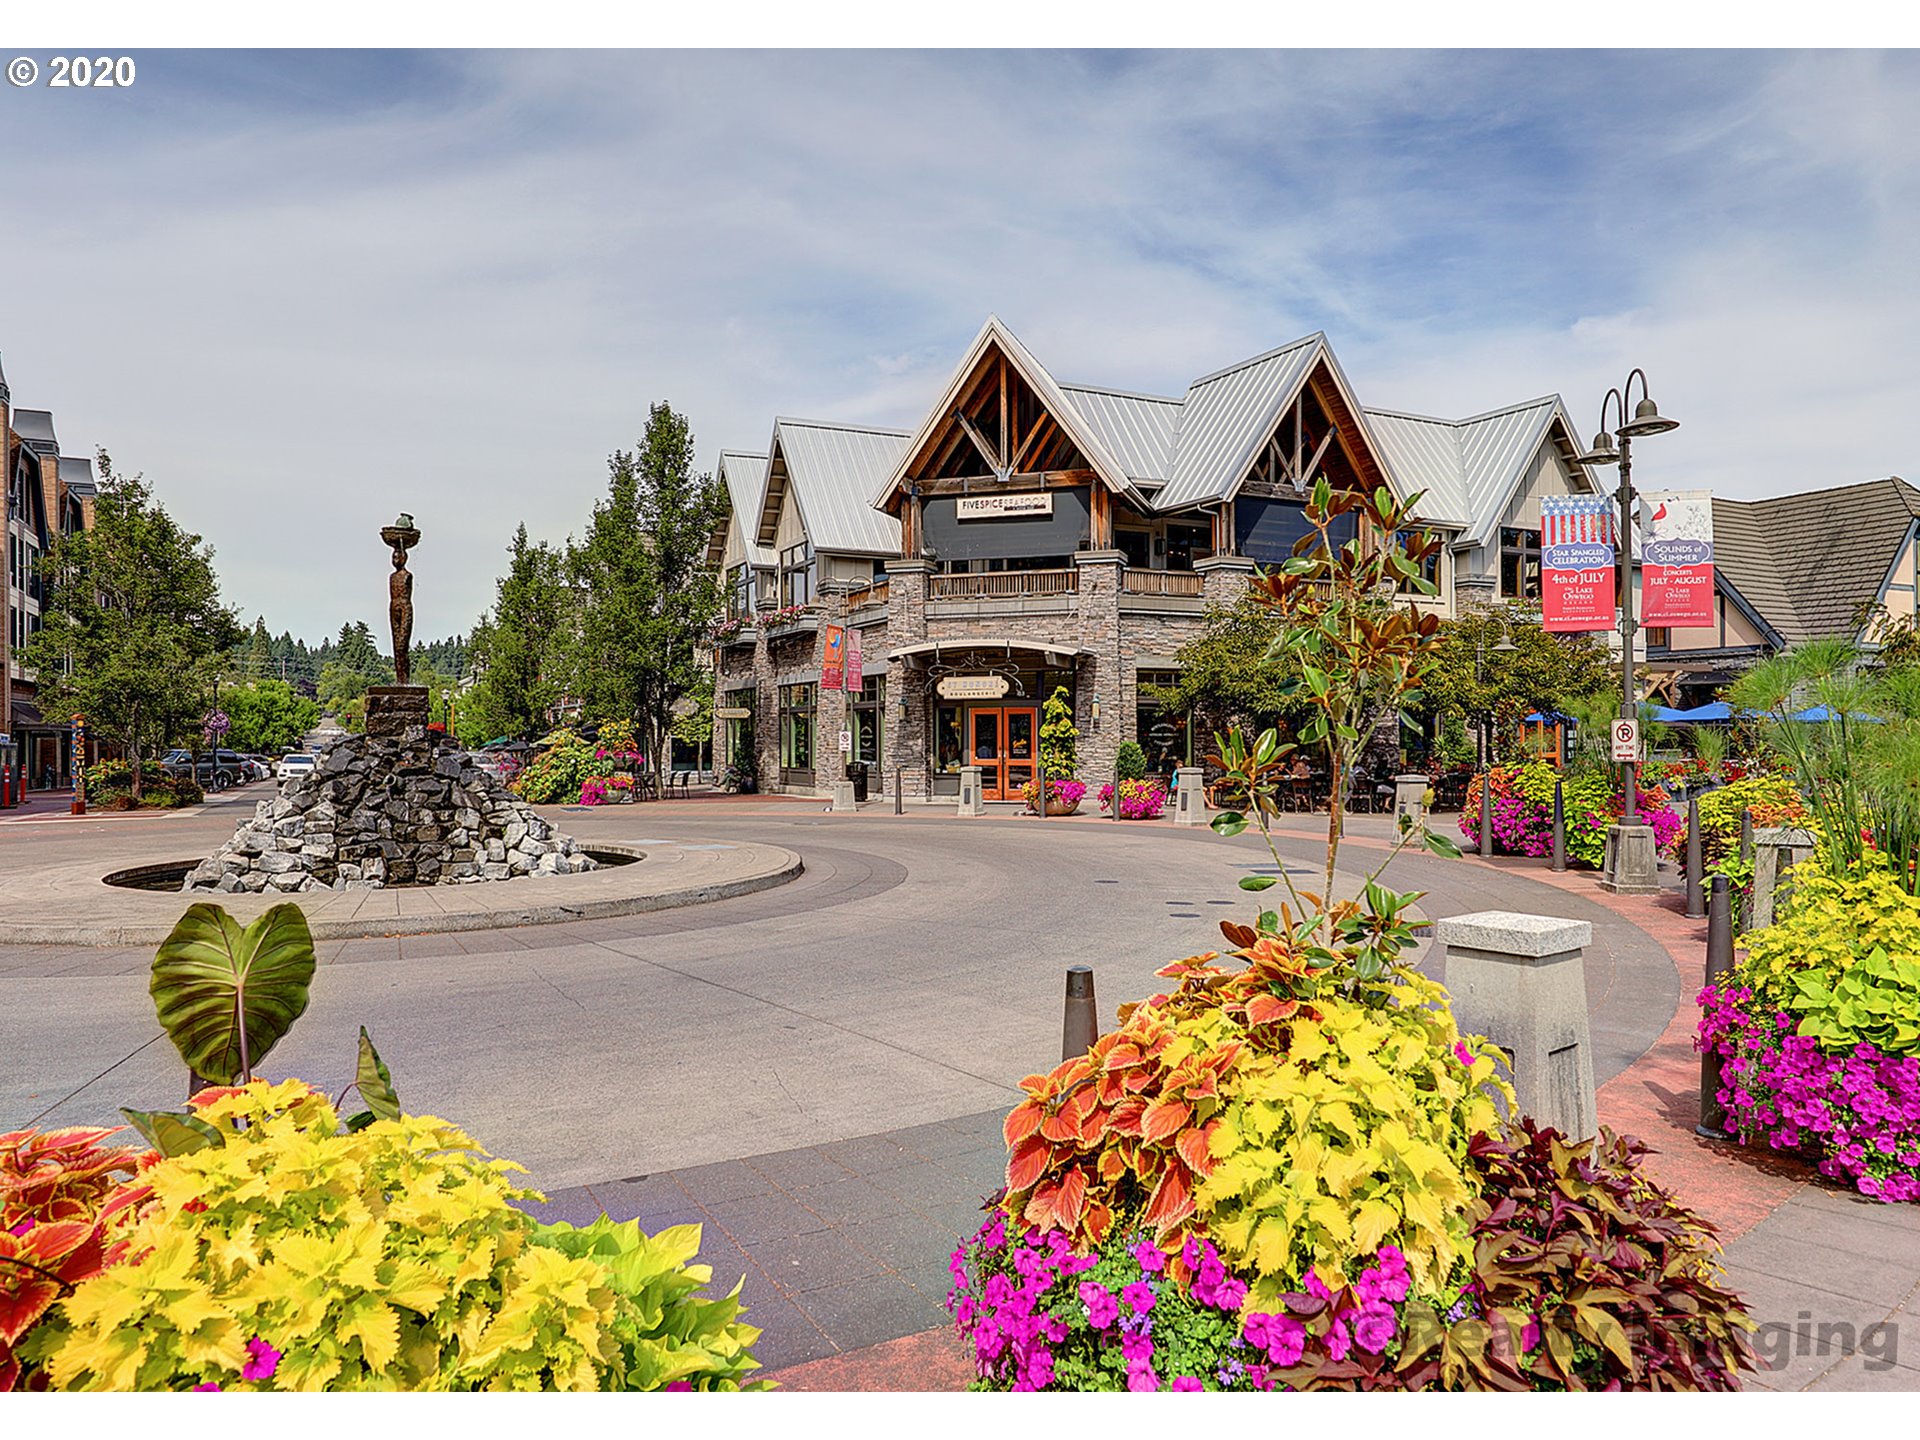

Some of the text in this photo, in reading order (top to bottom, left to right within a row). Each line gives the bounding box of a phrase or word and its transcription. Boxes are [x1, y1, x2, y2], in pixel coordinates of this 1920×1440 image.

[1552, 548, 1605, 557] STAR SPANGLED
[1653, 544, 1703, 554] SOUNDS of
[1552, 556, 1605, 565] CELEBRATION
[1658, 553, 1698, 562] SUMMER
[1551, 572, 1605, 585] 4th of JULY
[1650, 577, 1669, 586] JULY
[1674, 576, 1707, 585] AUGUST
